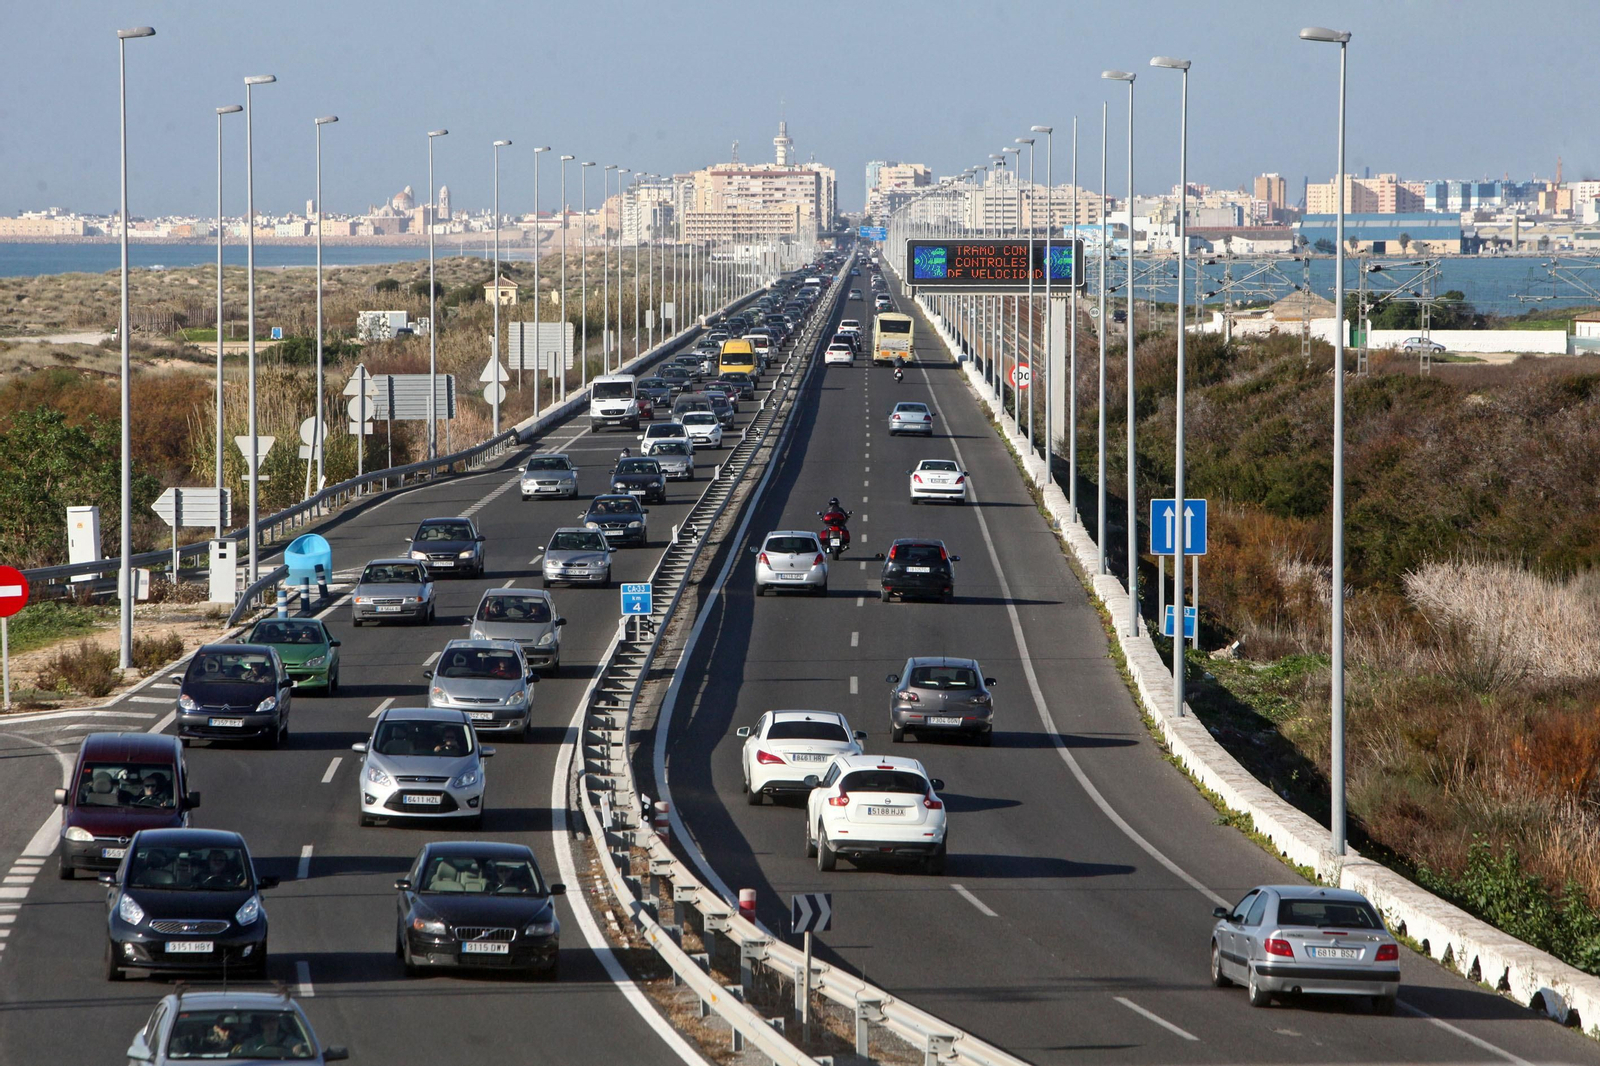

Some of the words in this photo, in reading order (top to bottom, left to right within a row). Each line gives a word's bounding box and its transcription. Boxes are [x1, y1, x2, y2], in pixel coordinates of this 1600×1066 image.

[957, 245, 995, 256] TRAMO
[1003, 245, 1027, 256] CON
[955, 257, 1027, 267] CONTROLES
[632, 602, 642, 612] 4
[872, 807, 890, 815] 5188
[1317, 949, 1337, 957] 6819
